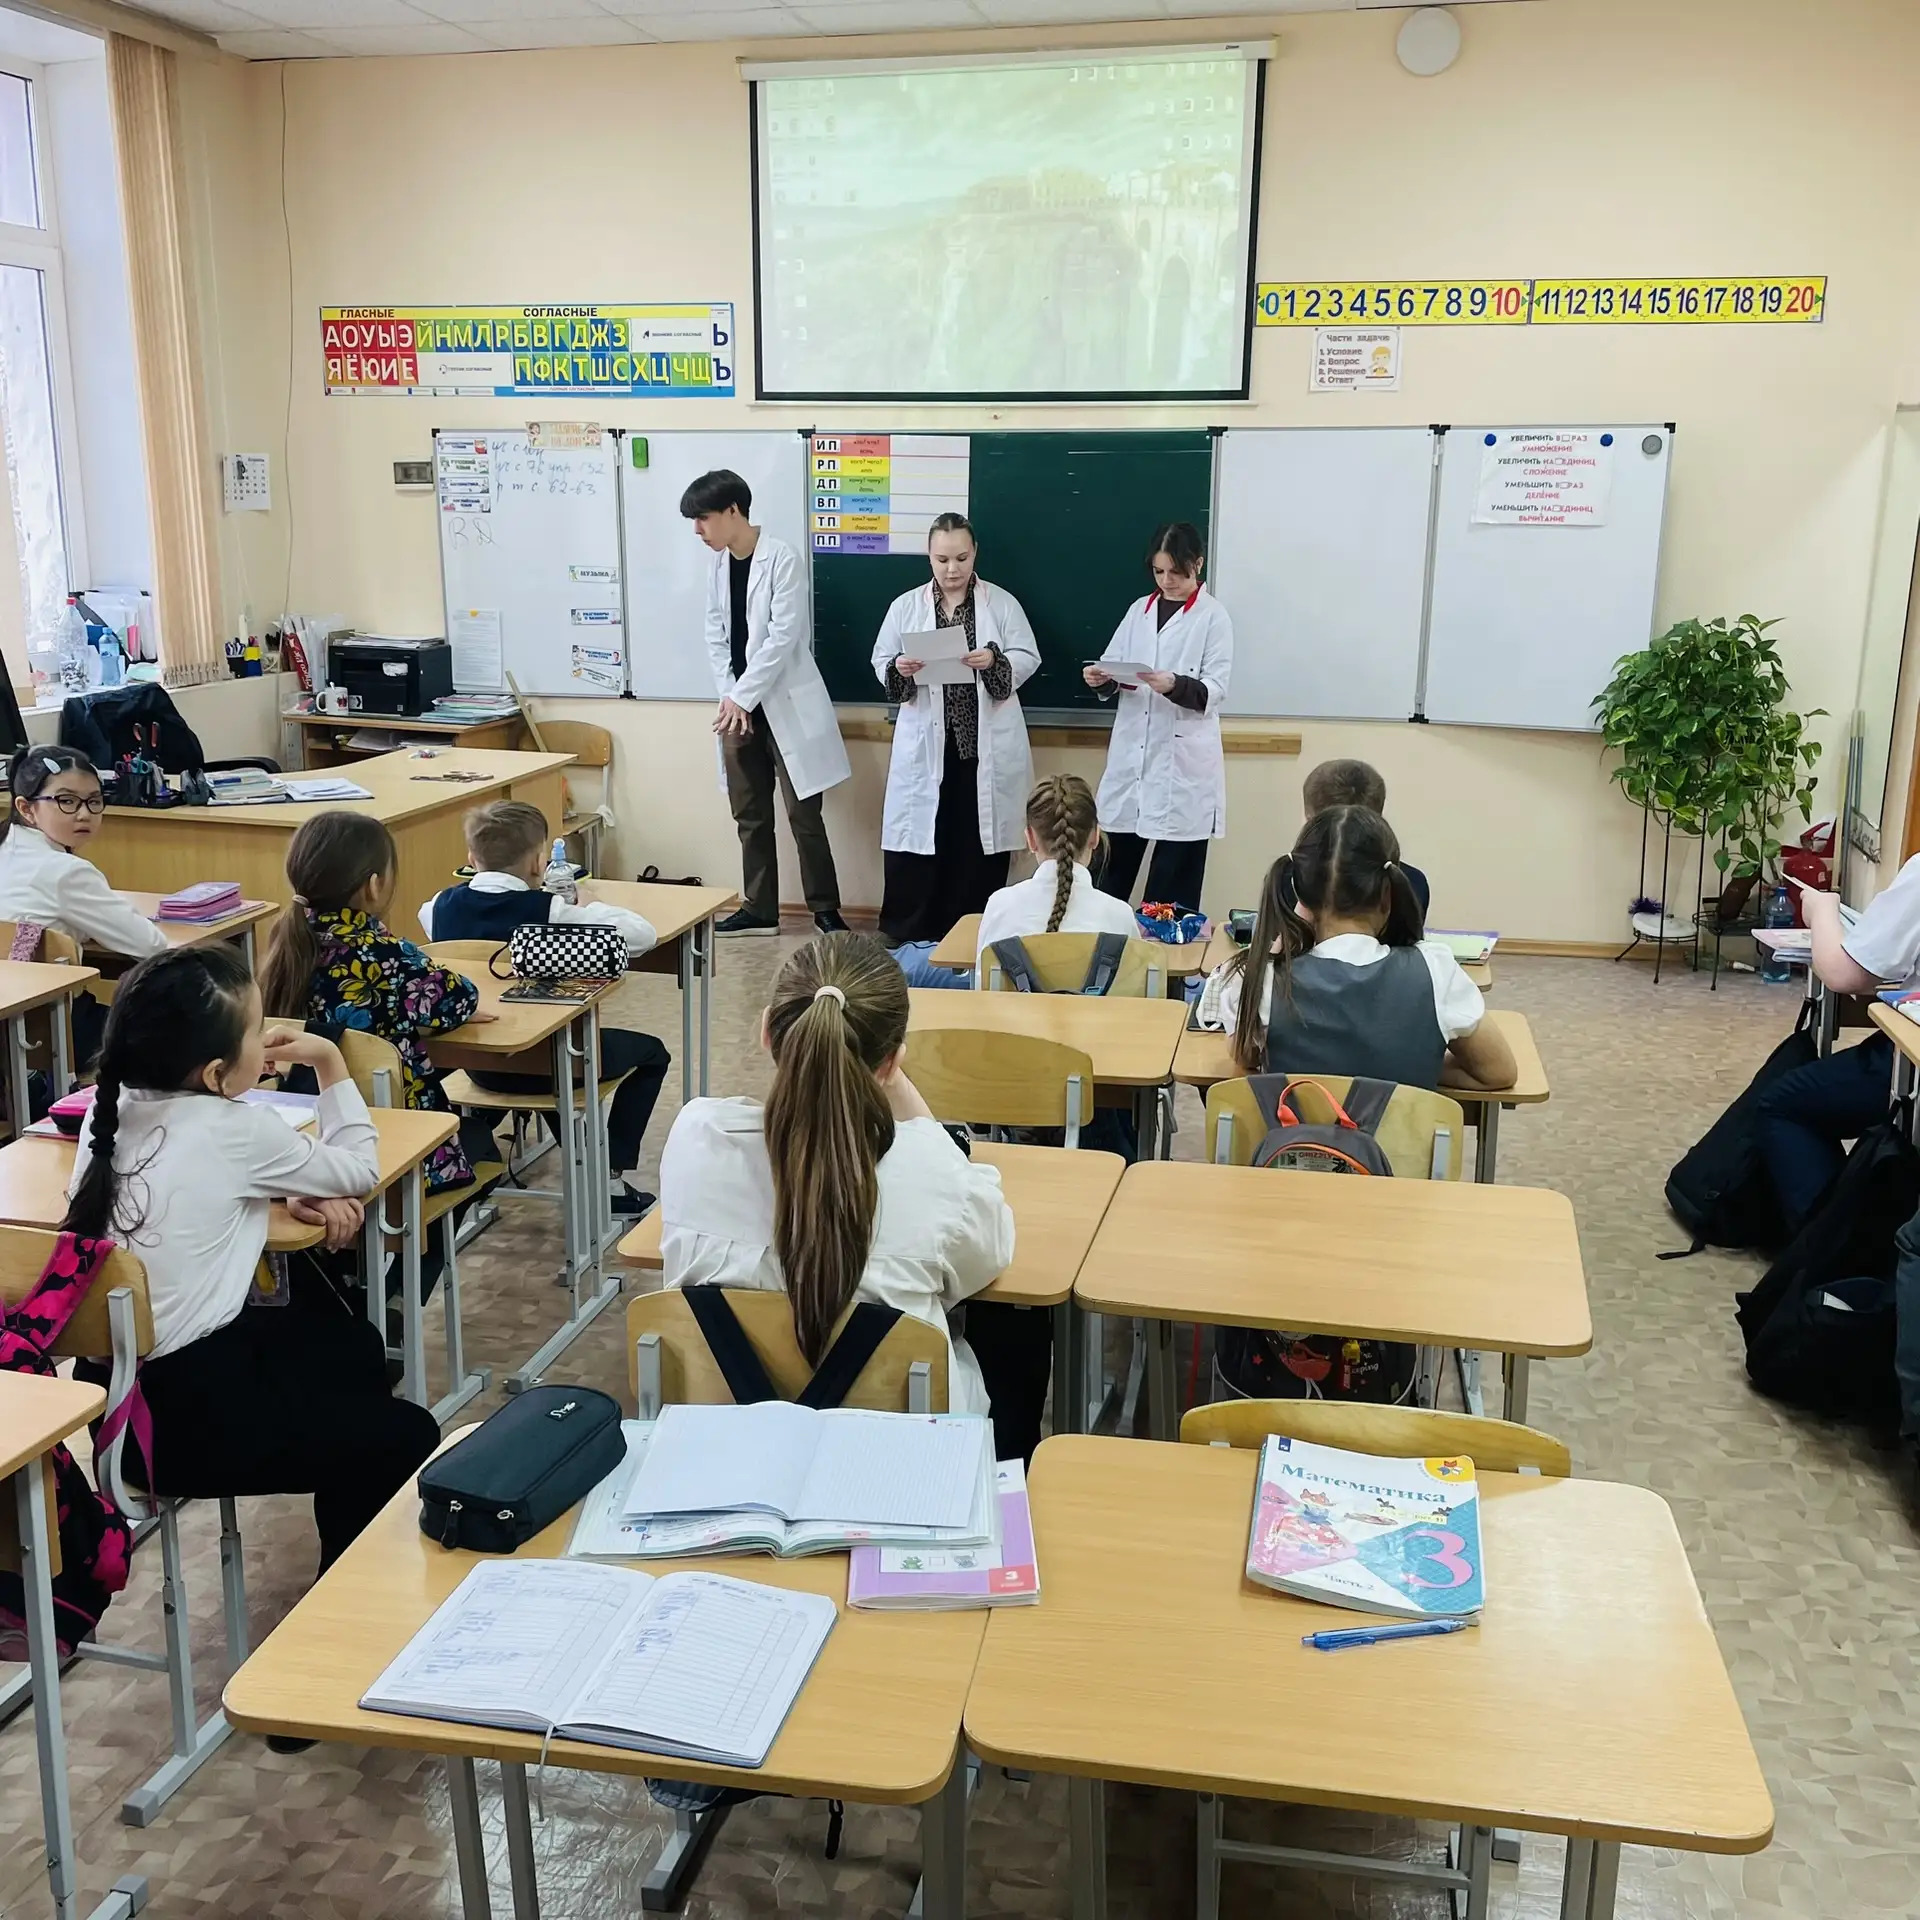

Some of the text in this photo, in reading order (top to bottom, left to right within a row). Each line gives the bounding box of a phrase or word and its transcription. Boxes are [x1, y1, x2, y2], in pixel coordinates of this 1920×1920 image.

[1265, 288, 1520, 317] 0 1 2 3 4 5 6 7 8 9 10
[1541, 286, 1814, 314] 11 12 13 14 15 16 17 18 19 20
[340, 309, 394, 318] ГЛАСНЫЕ
[523, 307, 598, 318] СОГЛАСНЫЕ
[1326, 348, 1362, 356] Условие
[1328, 358, 1360, 366] Вопрос
[1522, 445, 1572, 453] УМНОЖЕНИЕ
[1523, 468, 1567, 476] СЛОЖЕНИЕ
[1525, 491, 1560, 500] ДЕЛЕНИЕ
[1491, 504, 1539, 512] УМЕНЬШИТЬ
[1519, 515, 1565, 523] ВЫЧИТАНИЕ
[1281, 1463, 1447, 1503] Математика
[1400, 1530, 1474, 1588] 3
[1005, 1570, 1018, 1580] 3
